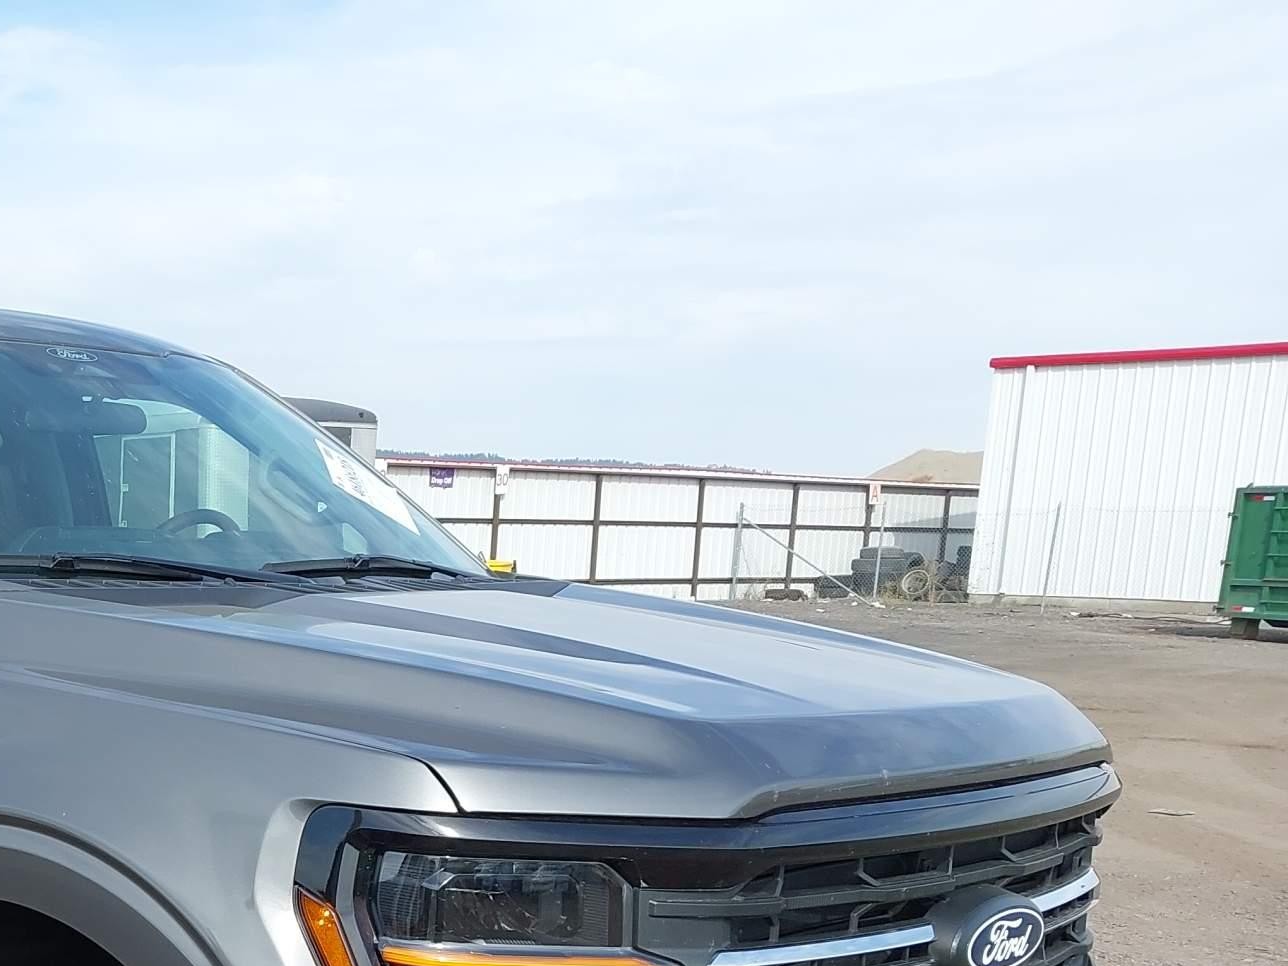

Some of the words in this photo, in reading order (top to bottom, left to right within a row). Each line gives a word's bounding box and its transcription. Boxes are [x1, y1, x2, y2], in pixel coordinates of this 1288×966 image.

[496, 473, 510, 487] 30
[870, 485, 879, 502] A
[982, 917, 1033, 966] Ford
